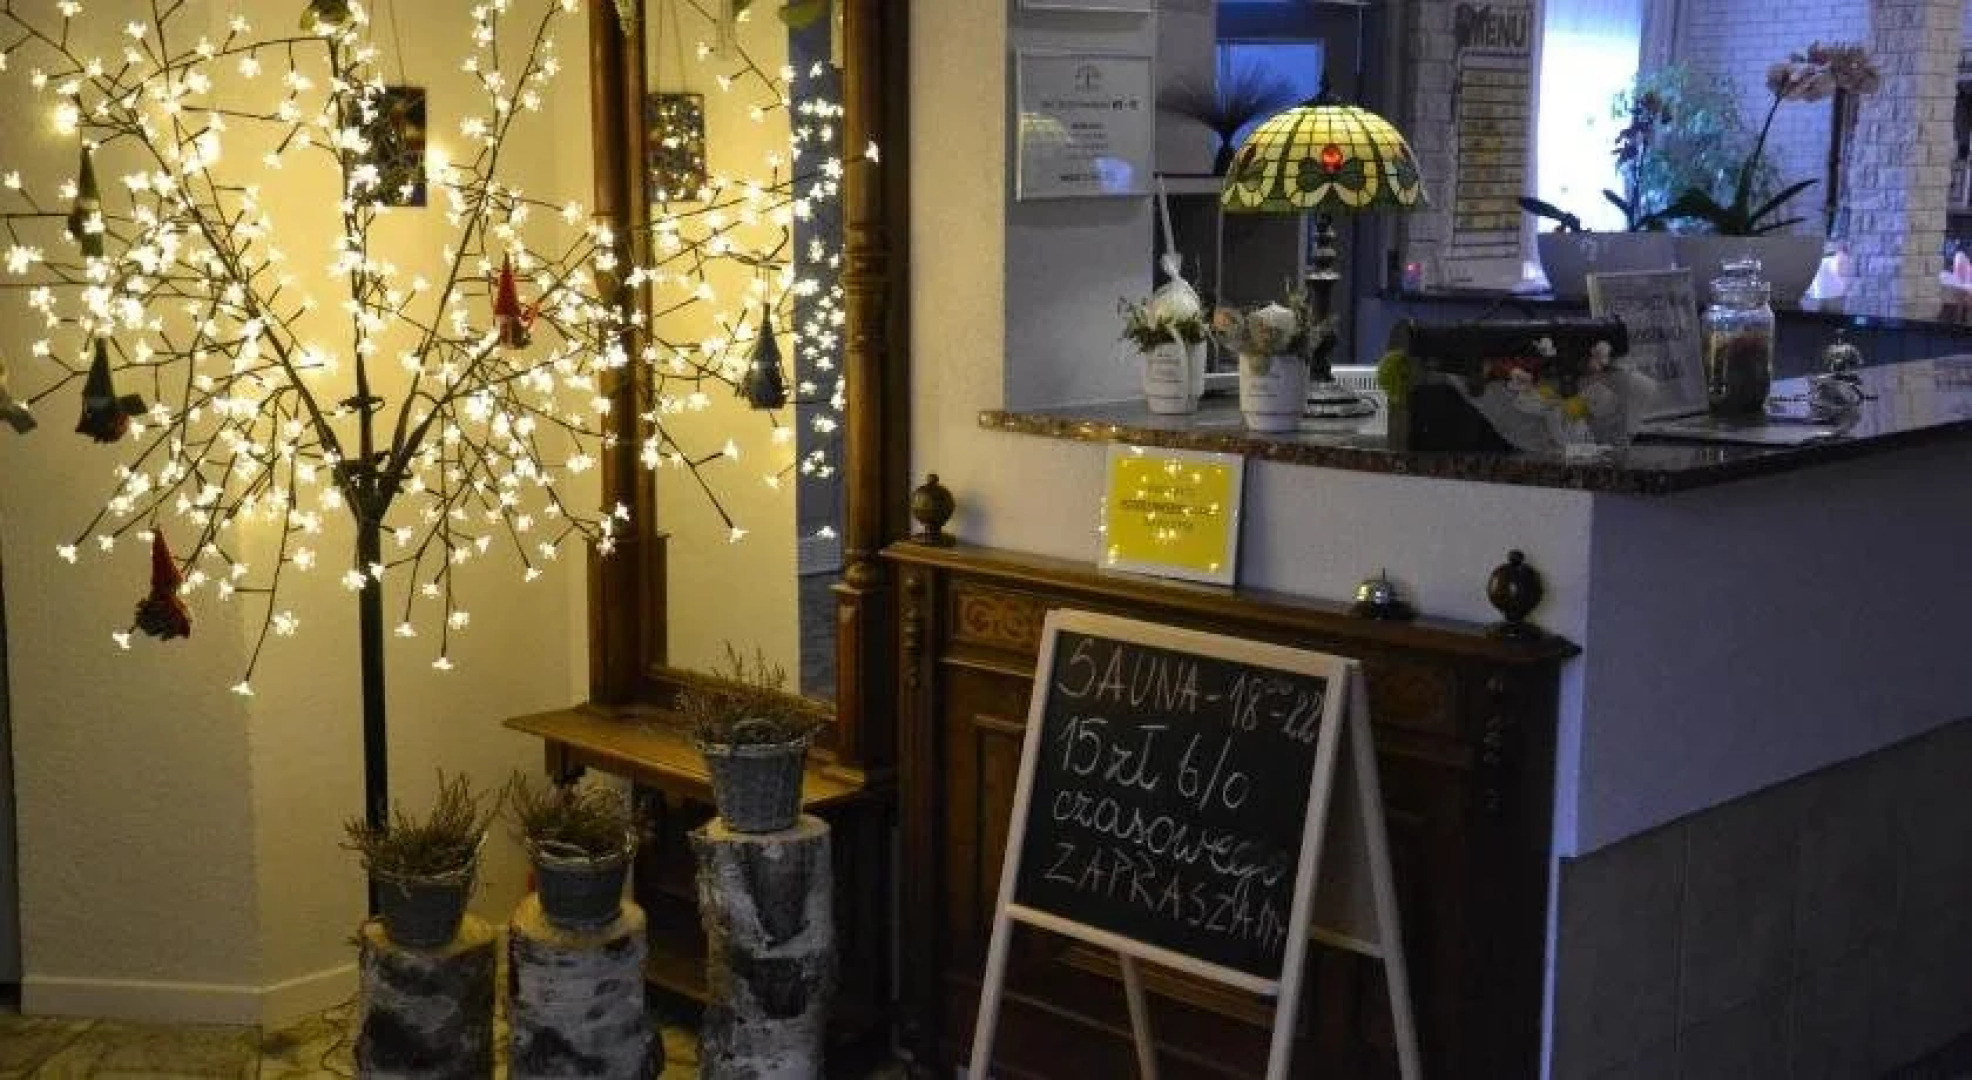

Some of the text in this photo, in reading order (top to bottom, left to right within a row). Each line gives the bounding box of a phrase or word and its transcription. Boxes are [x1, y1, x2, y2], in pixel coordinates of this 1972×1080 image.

[1470, 12, 1527, 48] MENU
[1057, 638, 1198, 714] SAUNA
[1052, 788, 1288, 888] czasowego
